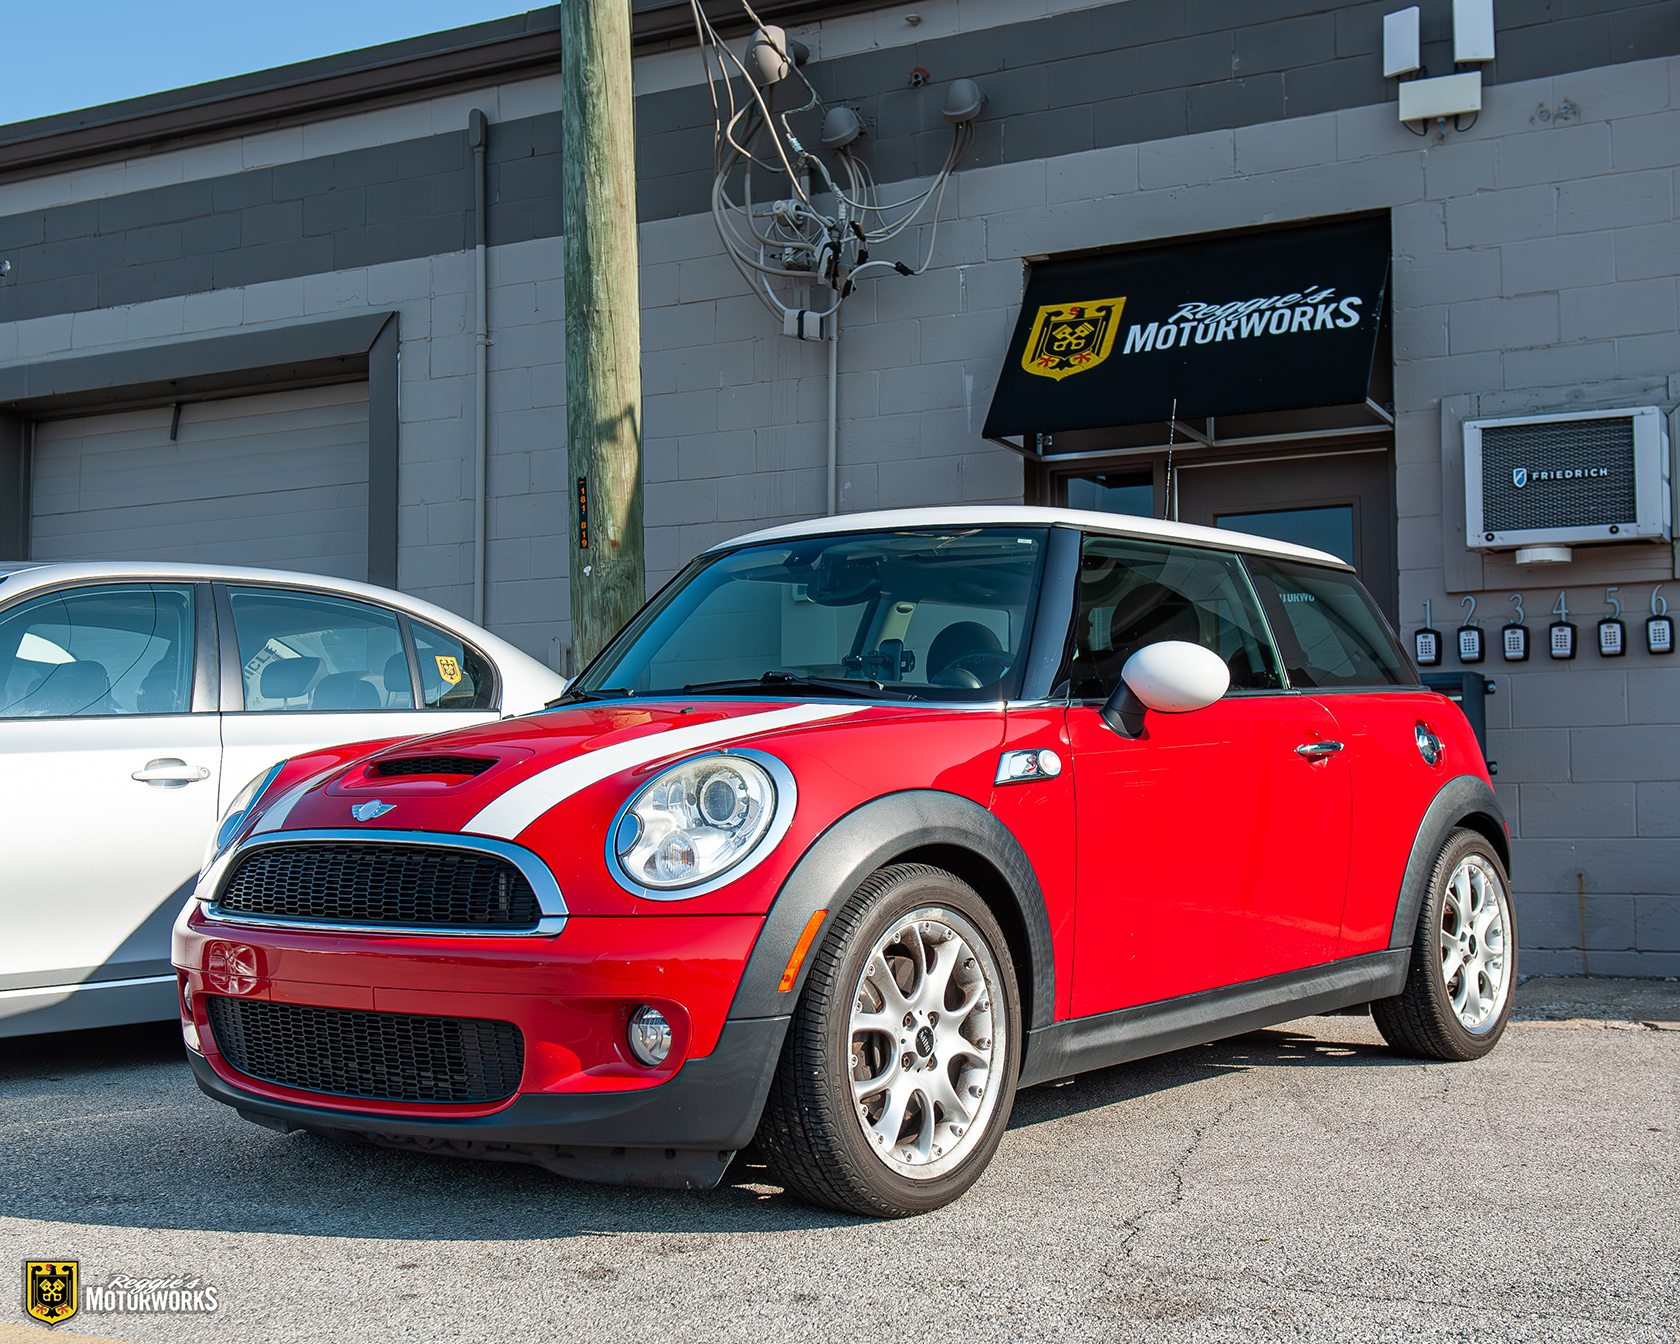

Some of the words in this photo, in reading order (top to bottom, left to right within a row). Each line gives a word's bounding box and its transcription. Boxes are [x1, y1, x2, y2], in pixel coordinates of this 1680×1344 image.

[1123, 296, 1363, 355] MOTORWORKS
[1168, 285, 1337, 325] Reggie's
[1532, 467, 1608, 481] FRIEDRICH
[1422, 598, 1432, 629] 1
[1460, 595, 1479, 627] 2
[1509, 593, 1525, 626] 3
[1552, 590, 1570, 623] 4
[1604, 586, 1621, 620] 5
[1651, 584, 1668, 617] 6
